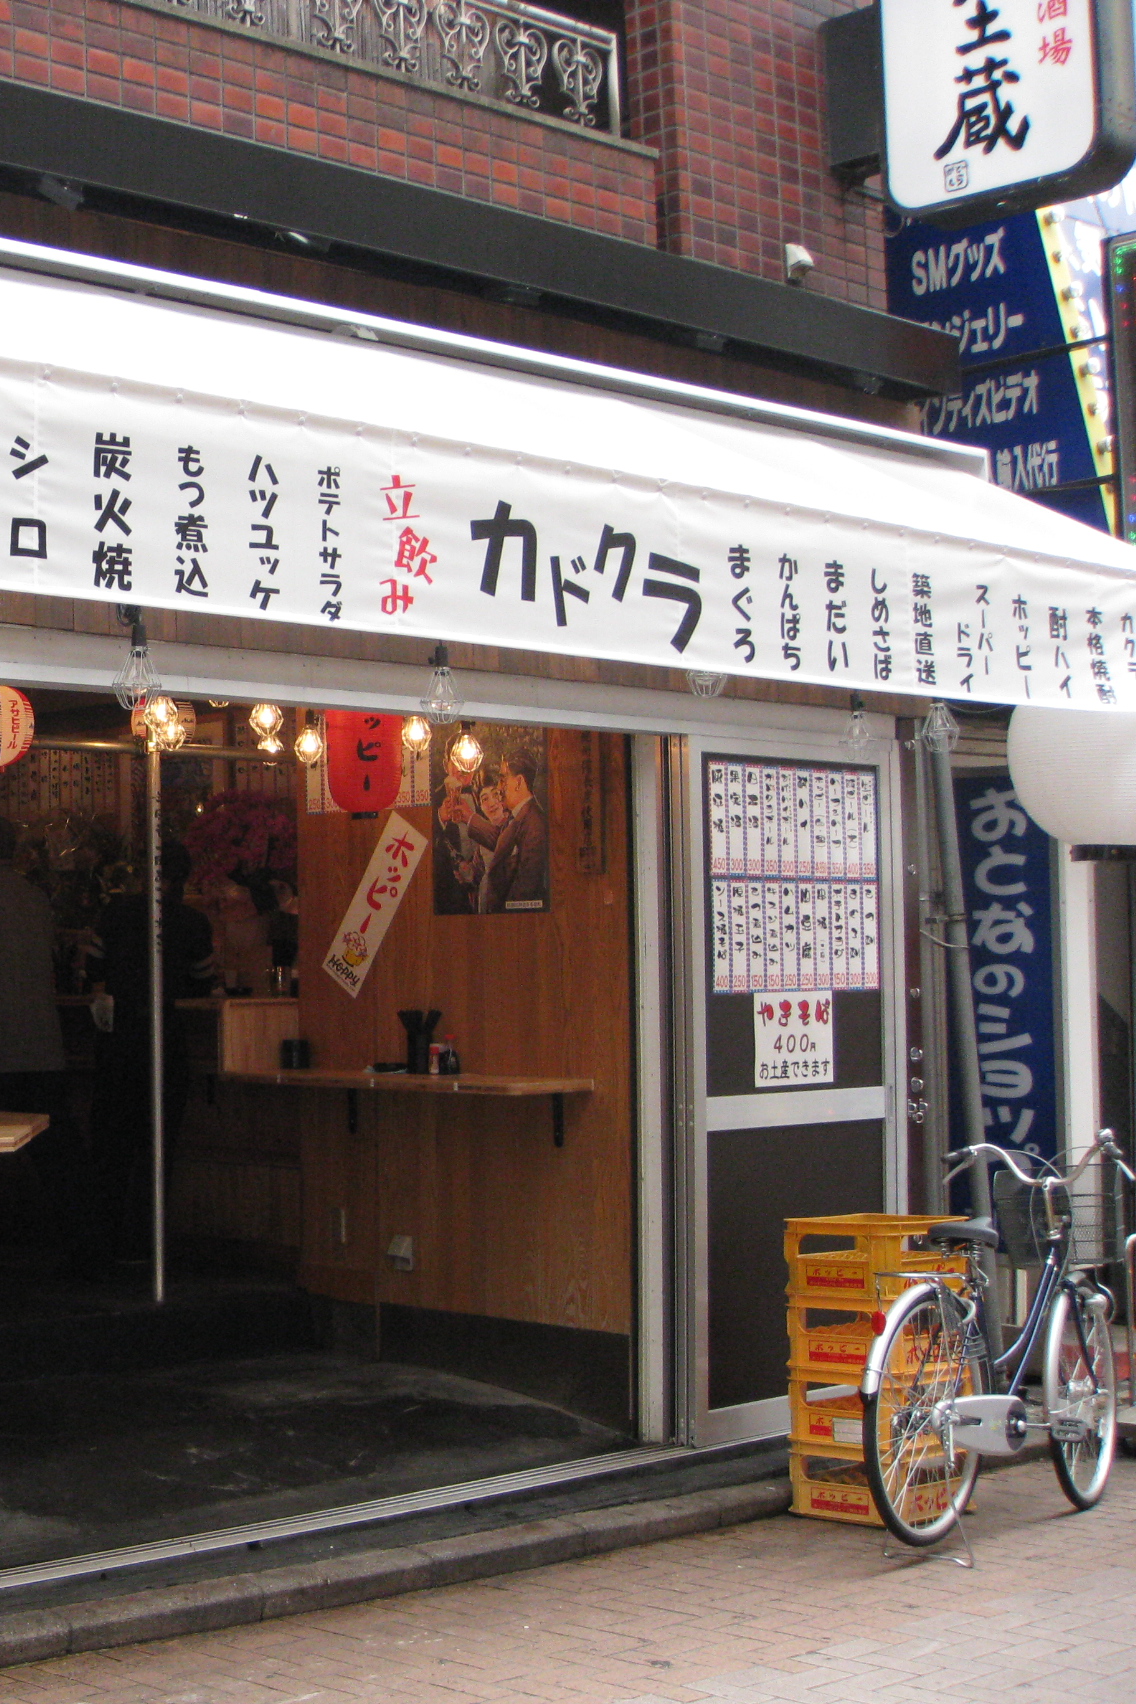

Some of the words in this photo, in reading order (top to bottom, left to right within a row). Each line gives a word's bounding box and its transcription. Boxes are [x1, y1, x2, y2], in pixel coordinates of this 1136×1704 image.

[933, 0, 1032, 161] 土蔵
[911, 226, 1006, 296] SMグッズ
[922, 302, 1024, 355] ジェリー
[9, 435, 48, 559] シロ
[92, 431, 133, 592] 炭火焼
[174, 444, 208, 598] もつ煮込
[247, 454, 280, 609] ハツユッケ
[317, 465, 342, 622] ポテトサラダ
[379, 474, 437, 616] 立飲み
[470, 499, 700, 653] カドクラ
[727, 543, 756, 664] まぐろ
[778, 552, 802, 671] かんぱち
[823, 559, 849, 673] まだい
[869, 567, 892, 681] しめさば
[911, 573, 937, 686] 築地直送
[975, 584, 994, 676] スーパー
[957, 622, 974, 693] ドライ
[1012, 594, 1032, 699] ホッピー
[1048, 606, 1072, 698] 酎ハイ
[8, 699, 21, 750] アサヒビール
[359, 830, 415, 935] ホッピー
[757, 998, 831, 1028] やきそば
[759, 1058, 830, 1080] お土産できます
[773, 1033, 817, 1054] 400円
